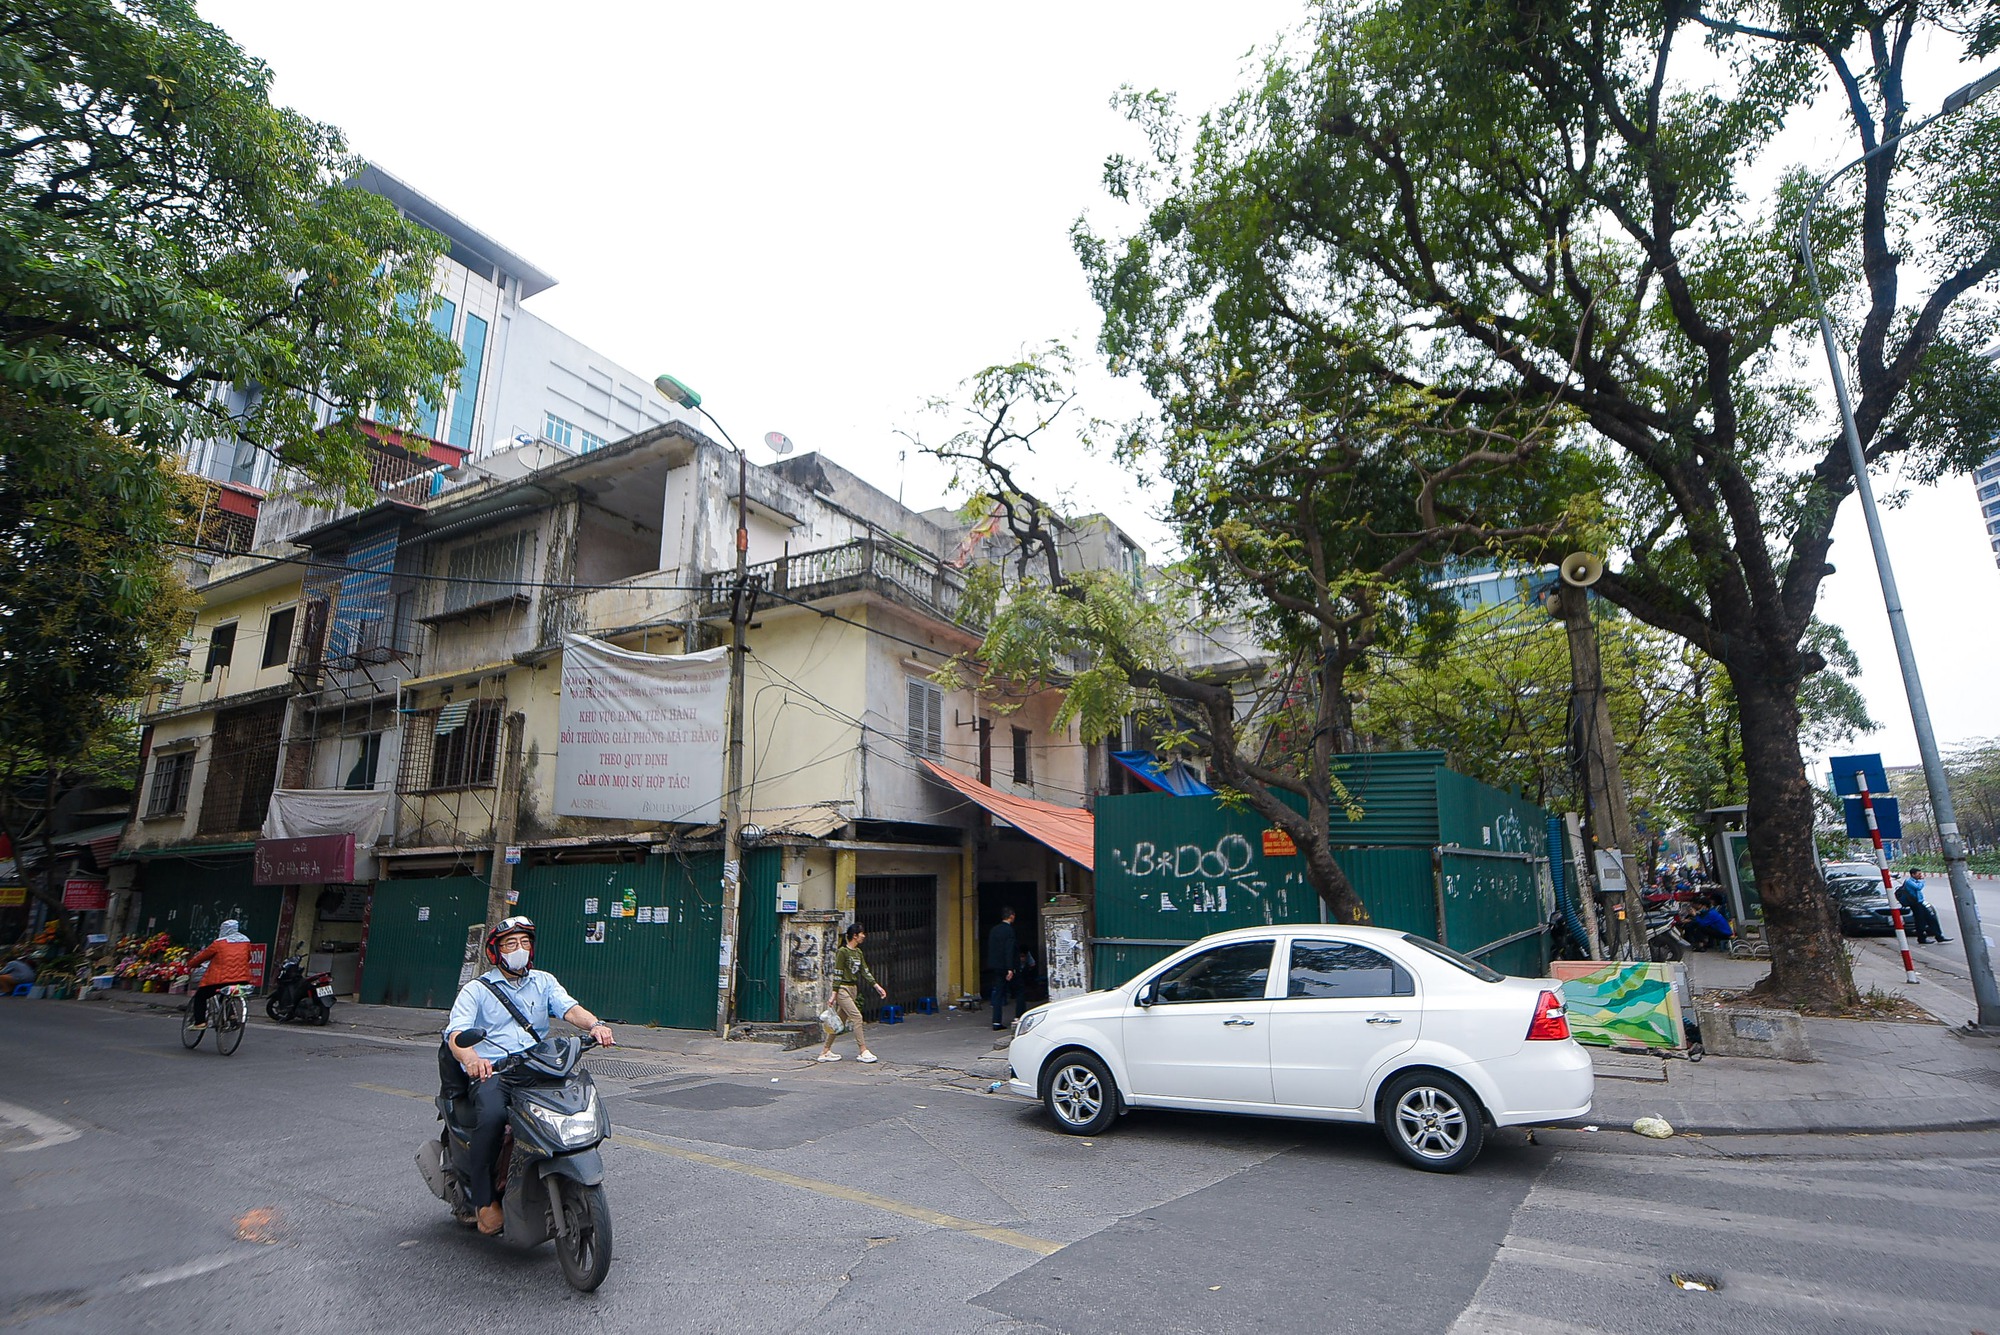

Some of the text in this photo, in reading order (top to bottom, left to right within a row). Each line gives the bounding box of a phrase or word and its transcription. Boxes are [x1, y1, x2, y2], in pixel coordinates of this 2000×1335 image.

[579, 711, 597, 723] KHU
[618, 710, 642, 722] ĐANG
[670, 705, 697, 721] HÀNH
[599, 753, 668, 769] THEO QUY ĐỊNH
[577, 769, 596, 786] CẢM
[598, 773, 610, 787] ƠN
[612, 775, 629, 790] MỌI
[646, 774, 665, 791] HỢP
